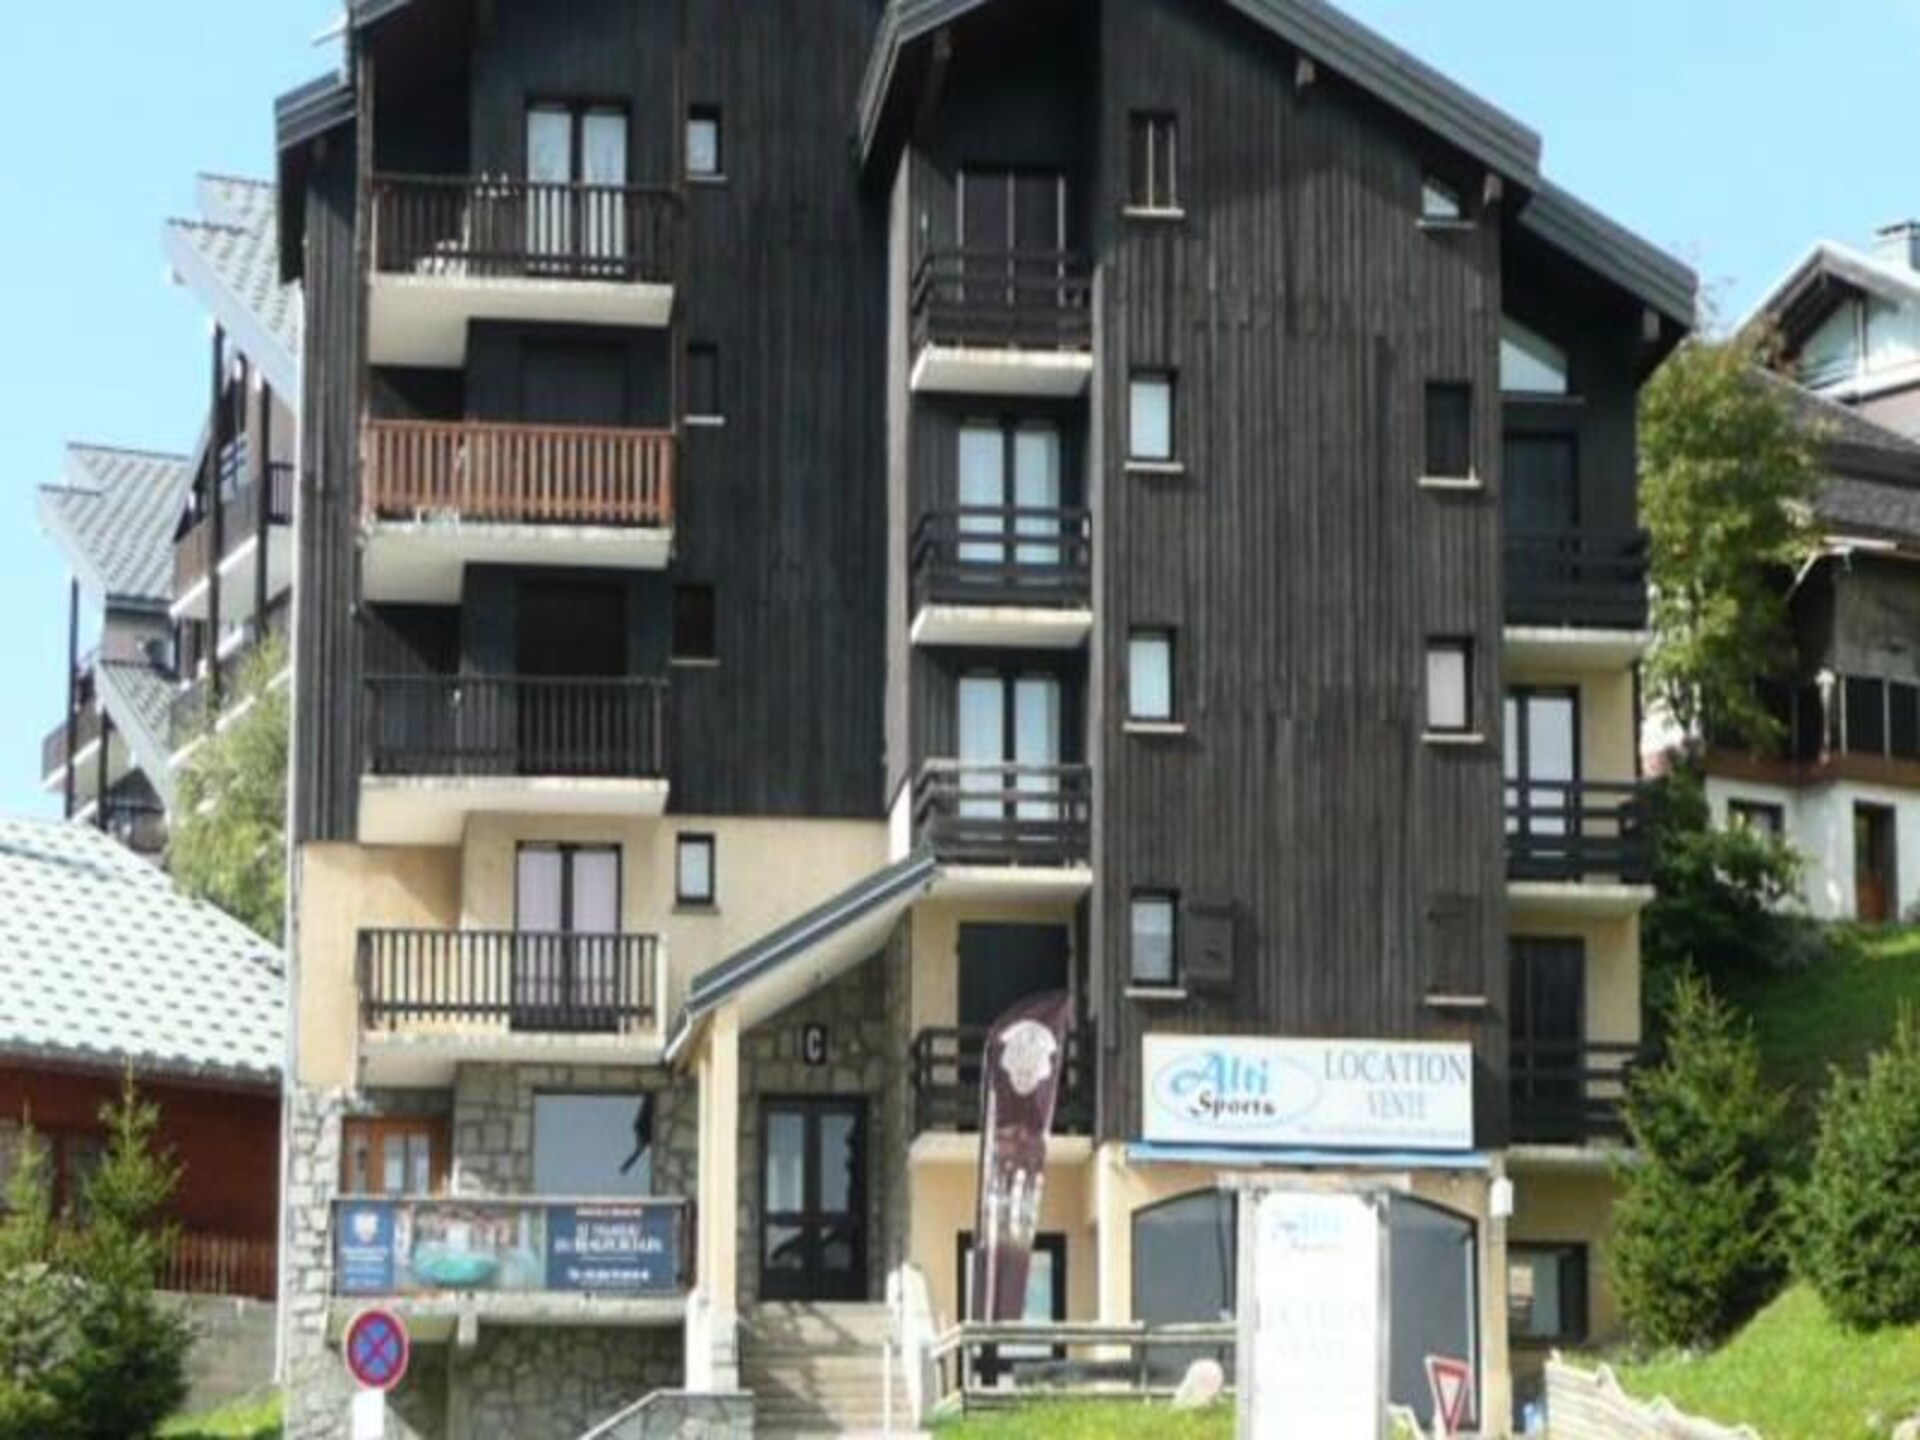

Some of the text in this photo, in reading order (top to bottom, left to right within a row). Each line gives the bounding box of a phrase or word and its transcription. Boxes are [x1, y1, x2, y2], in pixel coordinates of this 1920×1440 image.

[807, 1028, 821, 1061] C
[1169, 1050, 1269, 1097] Alti
[1323, 1049, 1467, 1083] LOCATION
[1189, 1089, 1276, 1120] Sports
[1366, 1089, 1427, 1120] VENTE
